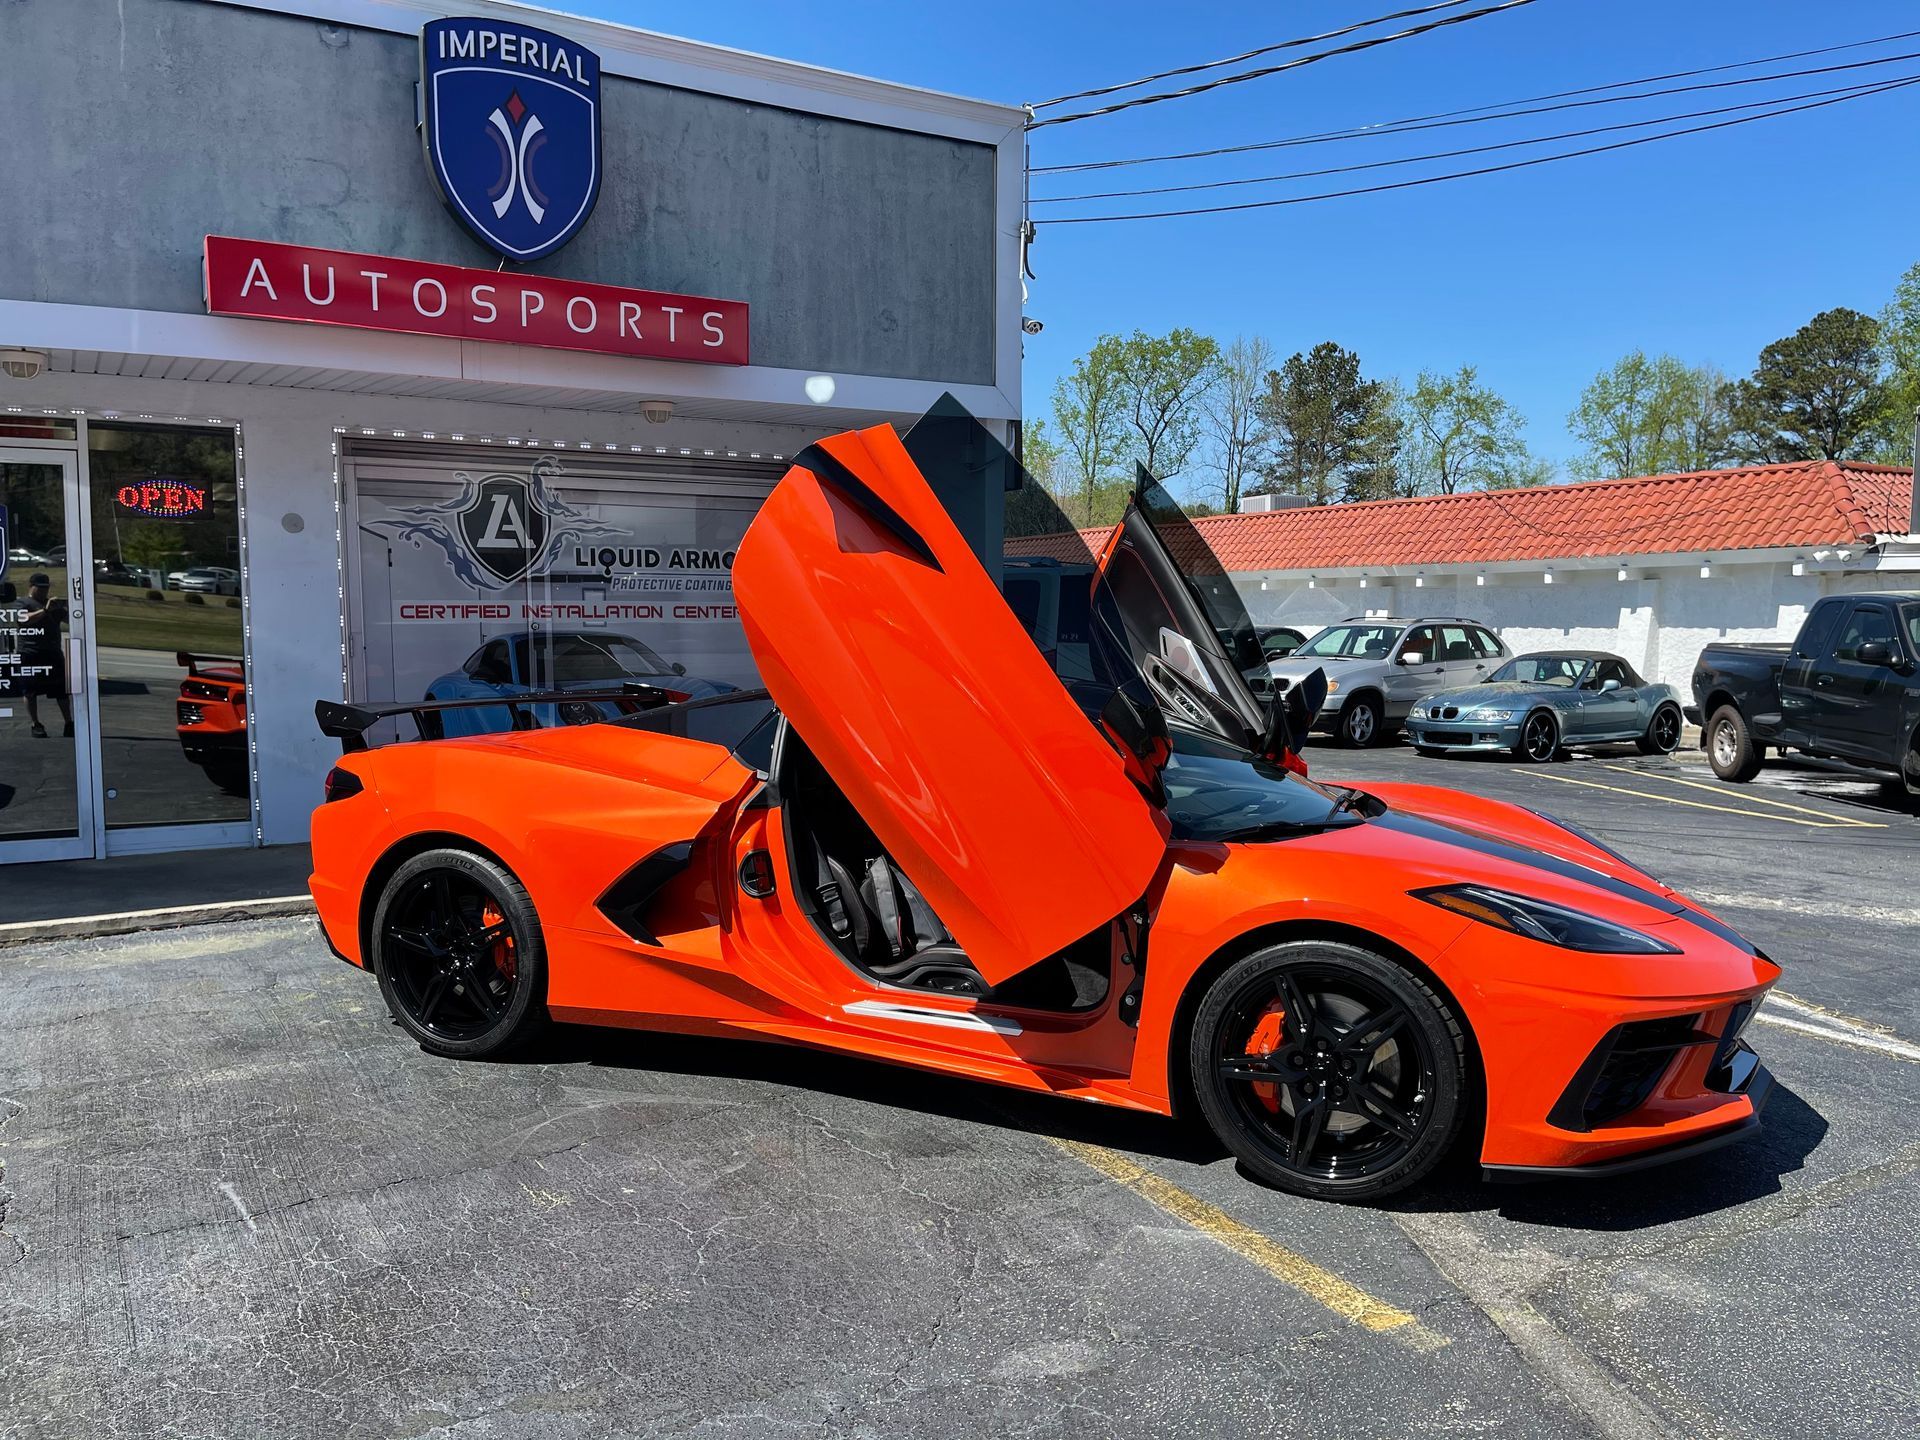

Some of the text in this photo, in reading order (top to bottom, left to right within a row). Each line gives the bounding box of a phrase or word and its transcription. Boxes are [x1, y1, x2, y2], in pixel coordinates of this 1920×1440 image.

[439, 29, 590, 87] IMPERIAL
[239, 257, 726, 348] AUTOSPORTS
[117, 486, 205, 510] OPEN
[575, 547, 660, 576] LIQUID
[612, 577, 732, 591] PROTECTIVE COATING
[400, 604, 510, 619] CERTIFIED
[522, 604, 663, 619] INSTALLATION
[0, 628, 45, 636] TS.COM
[10, 666, 53, 677] LEFT
